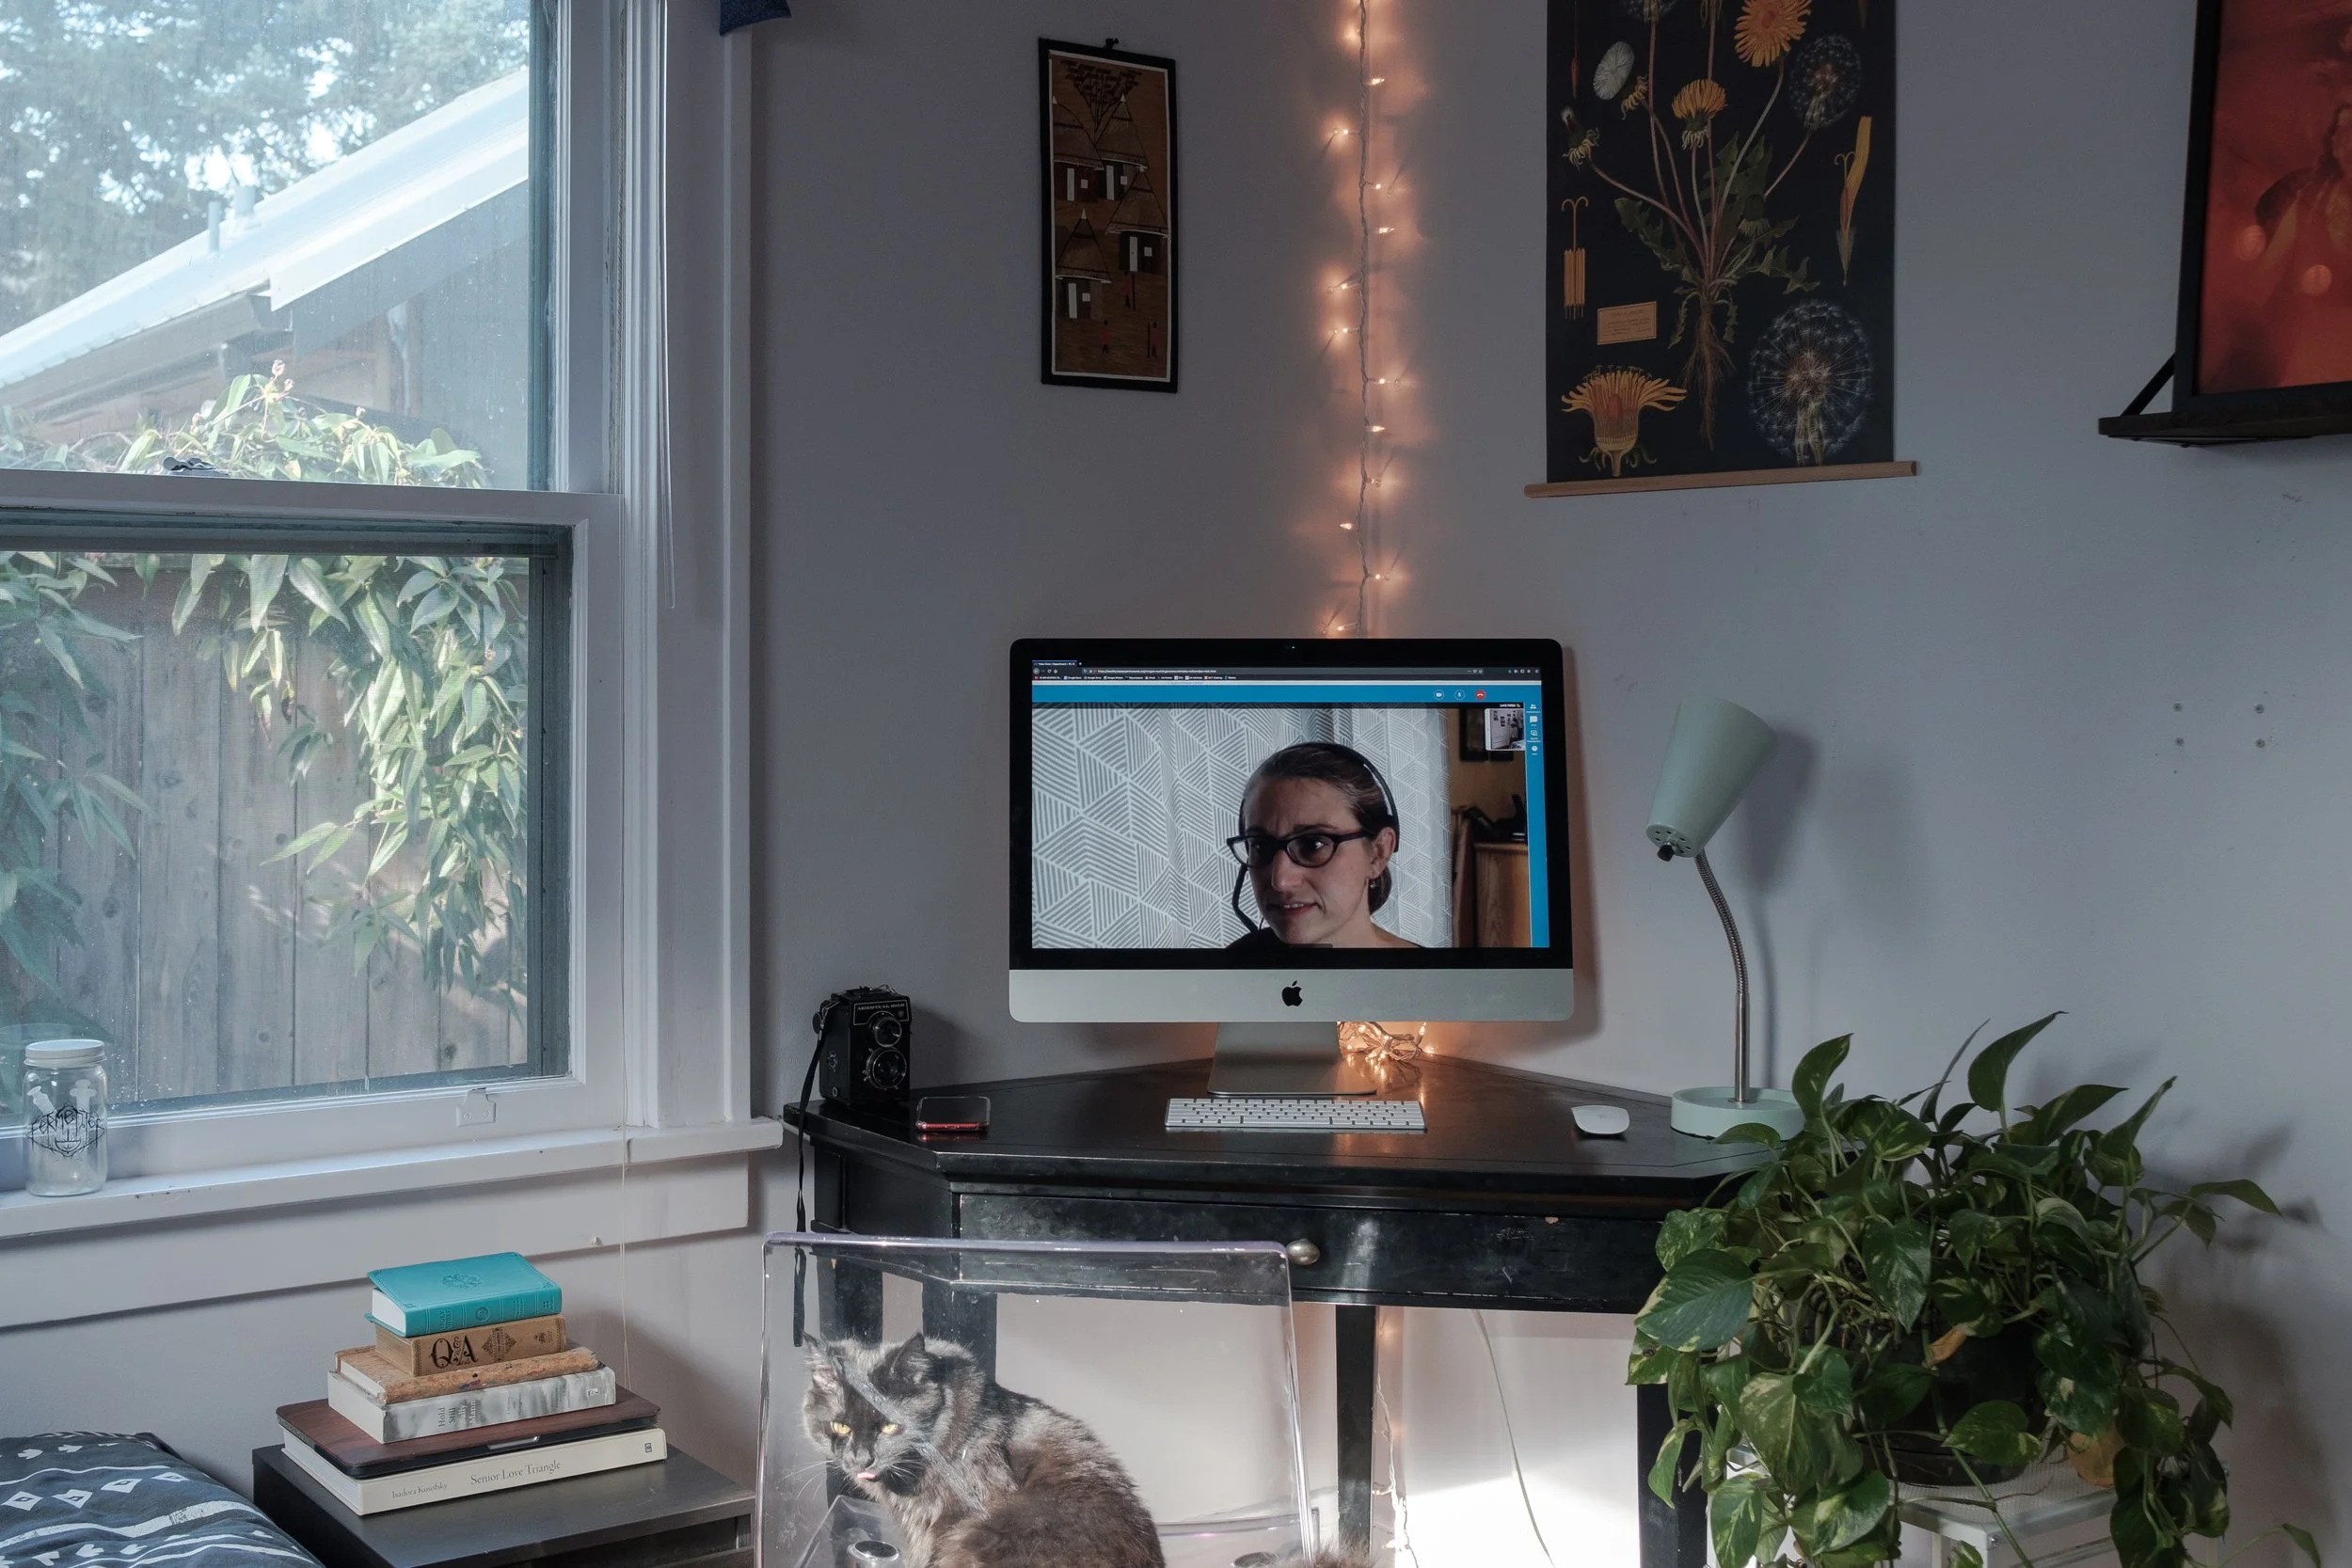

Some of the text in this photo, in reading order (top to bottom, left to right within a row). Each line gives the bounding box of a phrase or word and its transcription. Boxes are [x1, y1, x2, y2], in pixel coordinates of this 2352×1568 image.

[430, 1334, 479, 1369] Q&A
[448, 1407, 456, 1423] Still
[458, 1403, 468, 1423] Sally
[470, 1459, 562, 1486] Senior Love Triangle
[391, 1481, 448, 1498] Isadora Kosofsky
